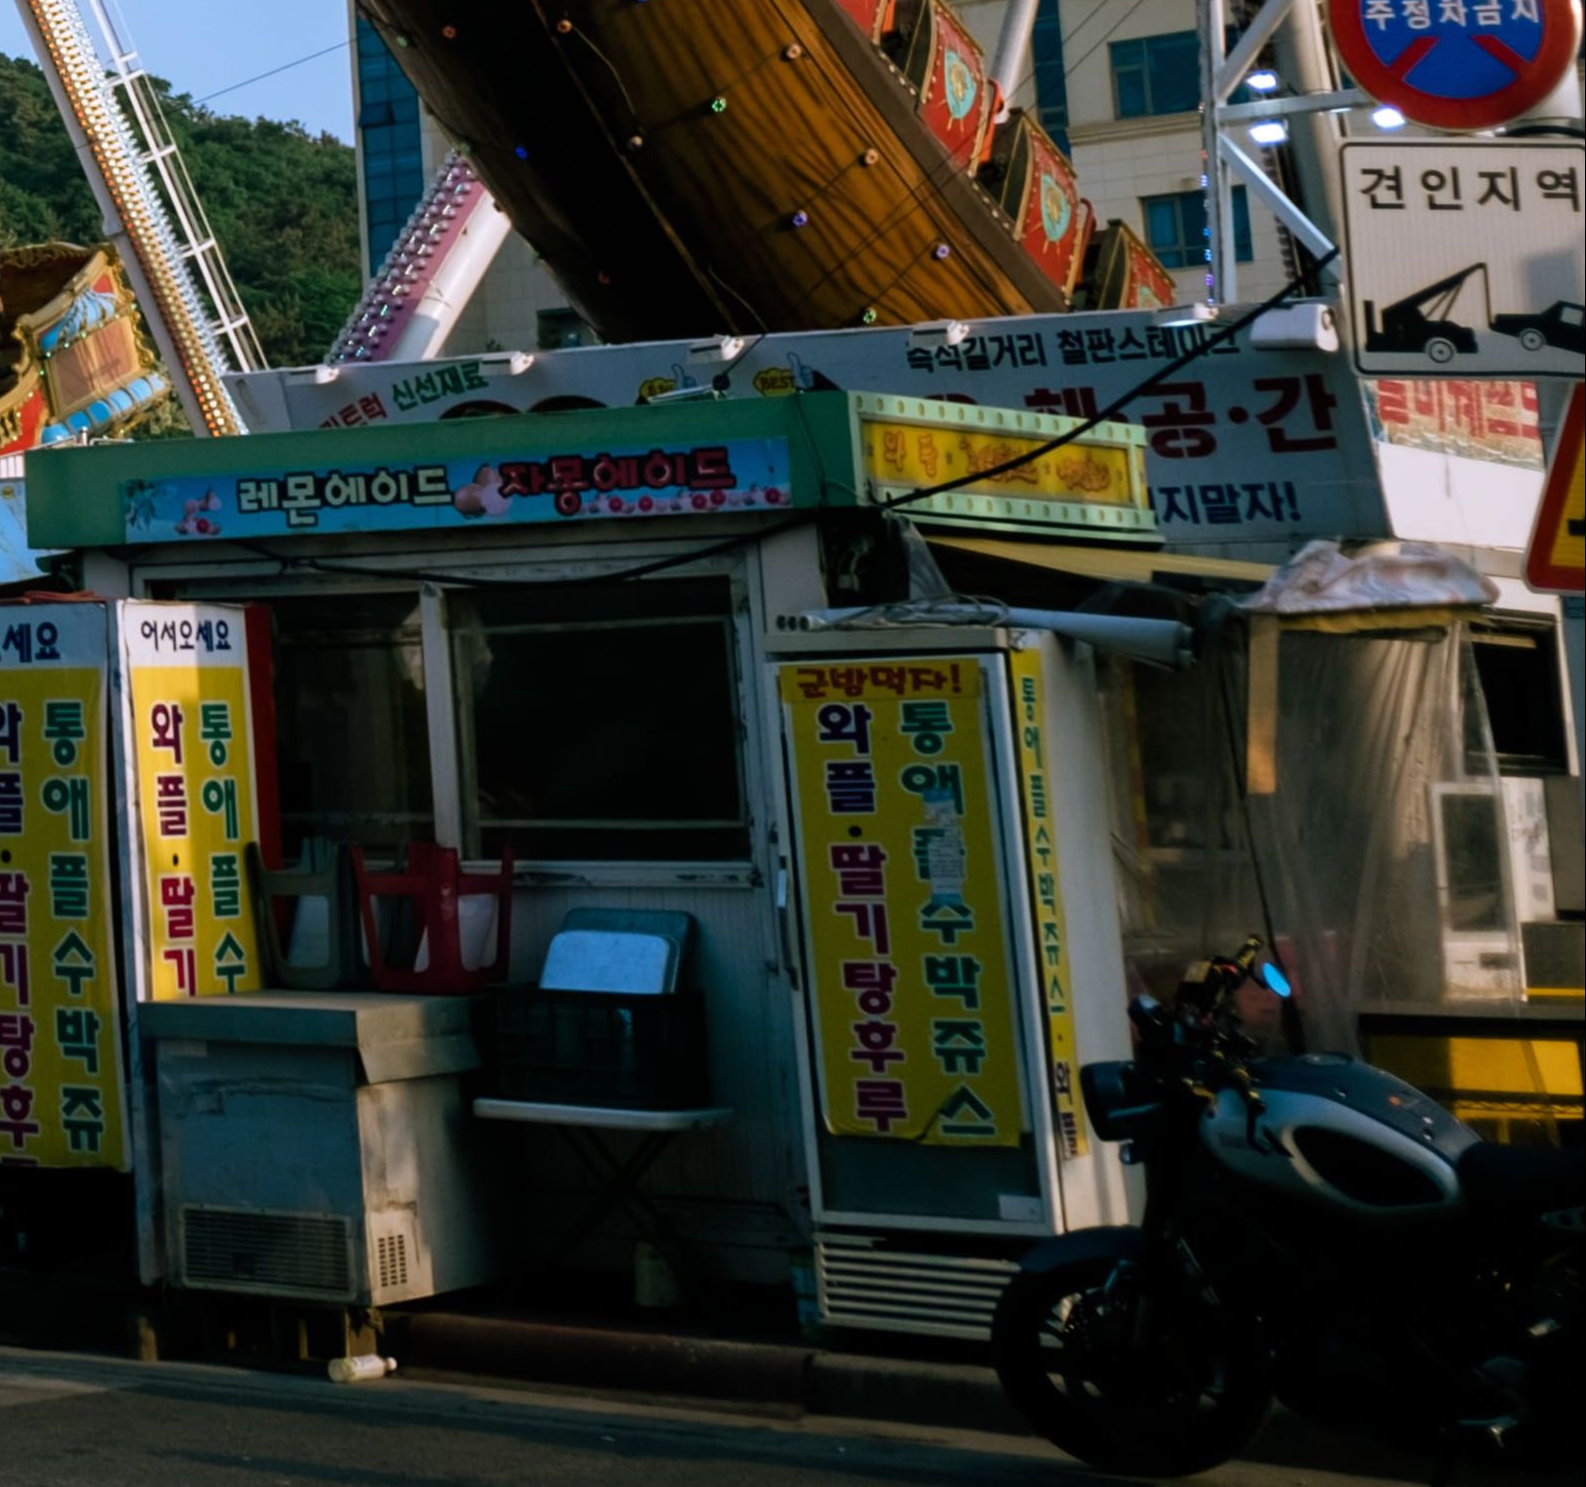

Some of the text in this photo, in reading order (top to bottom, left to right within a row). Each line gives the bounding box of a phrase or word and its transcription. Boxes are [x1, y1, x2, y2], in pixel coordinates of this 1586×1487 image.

[1360, 165, 1582, 213] 견인지역
[392, 362, 489, 411] 신선재료
[238, 446, 736, 527] 레몬에이드 자몽에이드
[1148, 481, 1303, 525] 지말자!
[139, 619, 233, 652] 어서오세요
